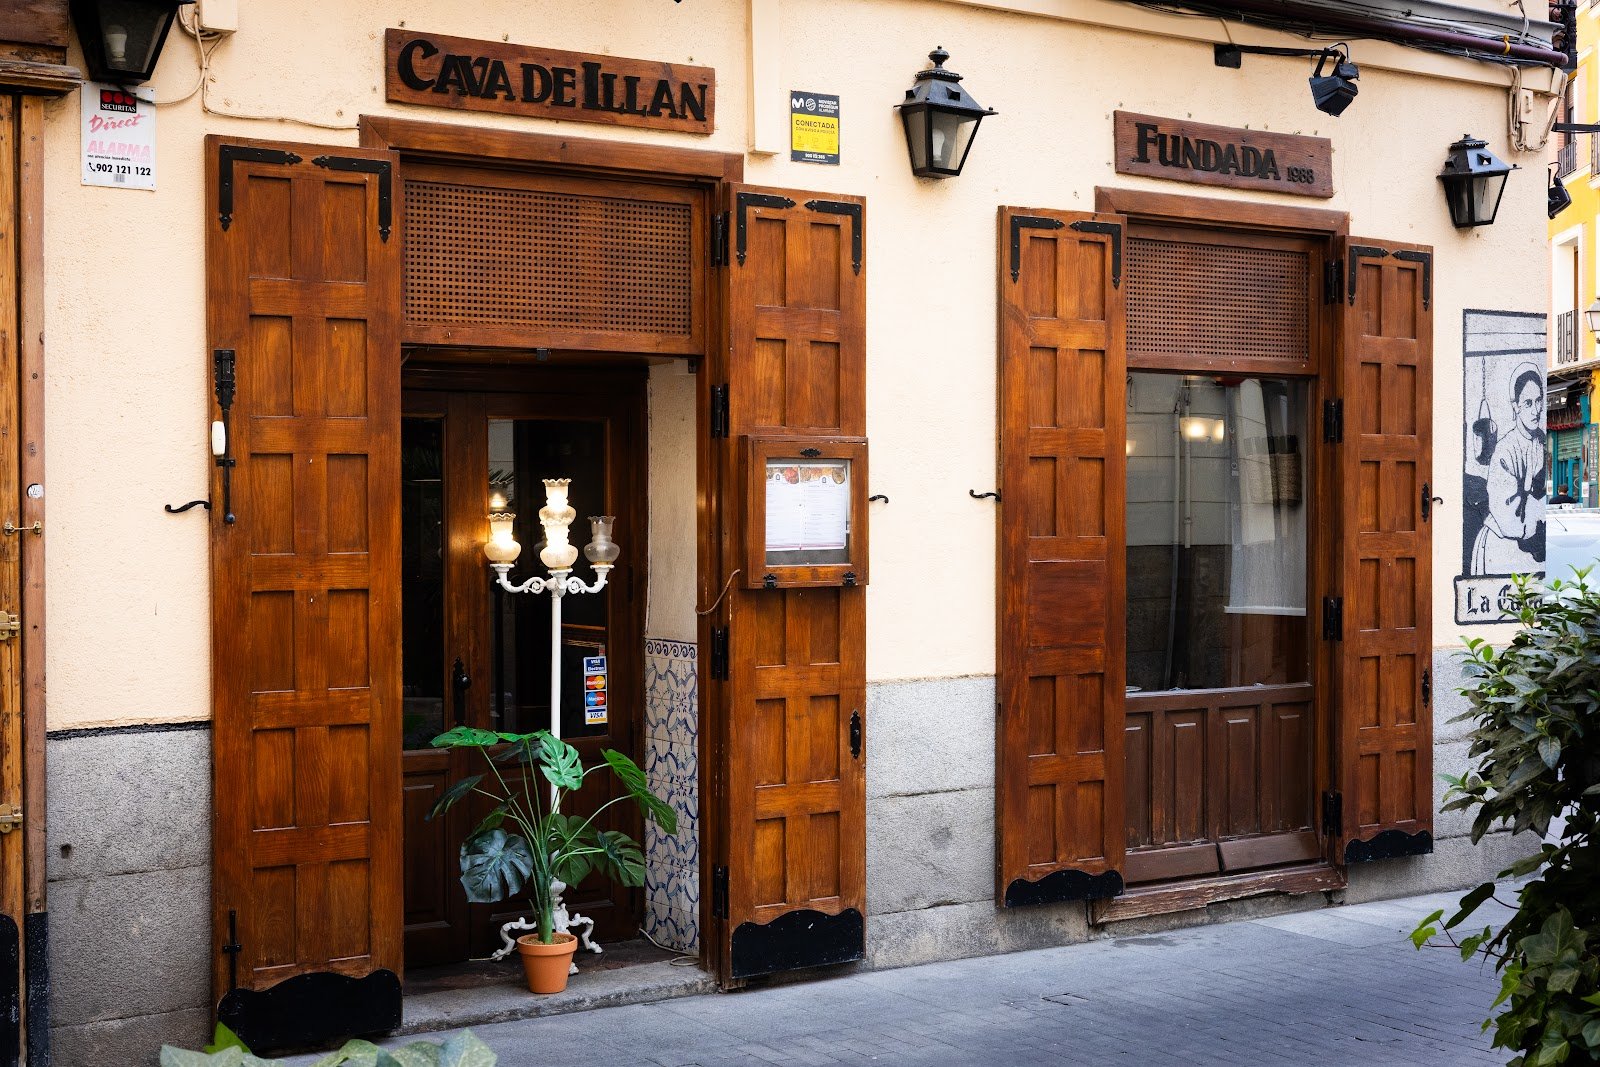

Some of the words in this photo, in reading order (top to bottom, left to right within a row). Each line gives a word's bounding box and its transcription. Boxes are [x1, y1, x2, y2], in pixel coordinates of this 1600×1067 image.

[582, 62, 708, 122] ILLAN
[101, 104, 136, 112] SECURITAS
[89, 113, 147, 133] Direct
[796, 119, 835, 128] CONECTADA
[87, 140, 150, 159] ALARMA
[96, 163, 113, 173] 902
[116, 165, 131, 175] 121
[135, 166, 151, 176] 122
[1286, 166, 1315, 184] 1988
